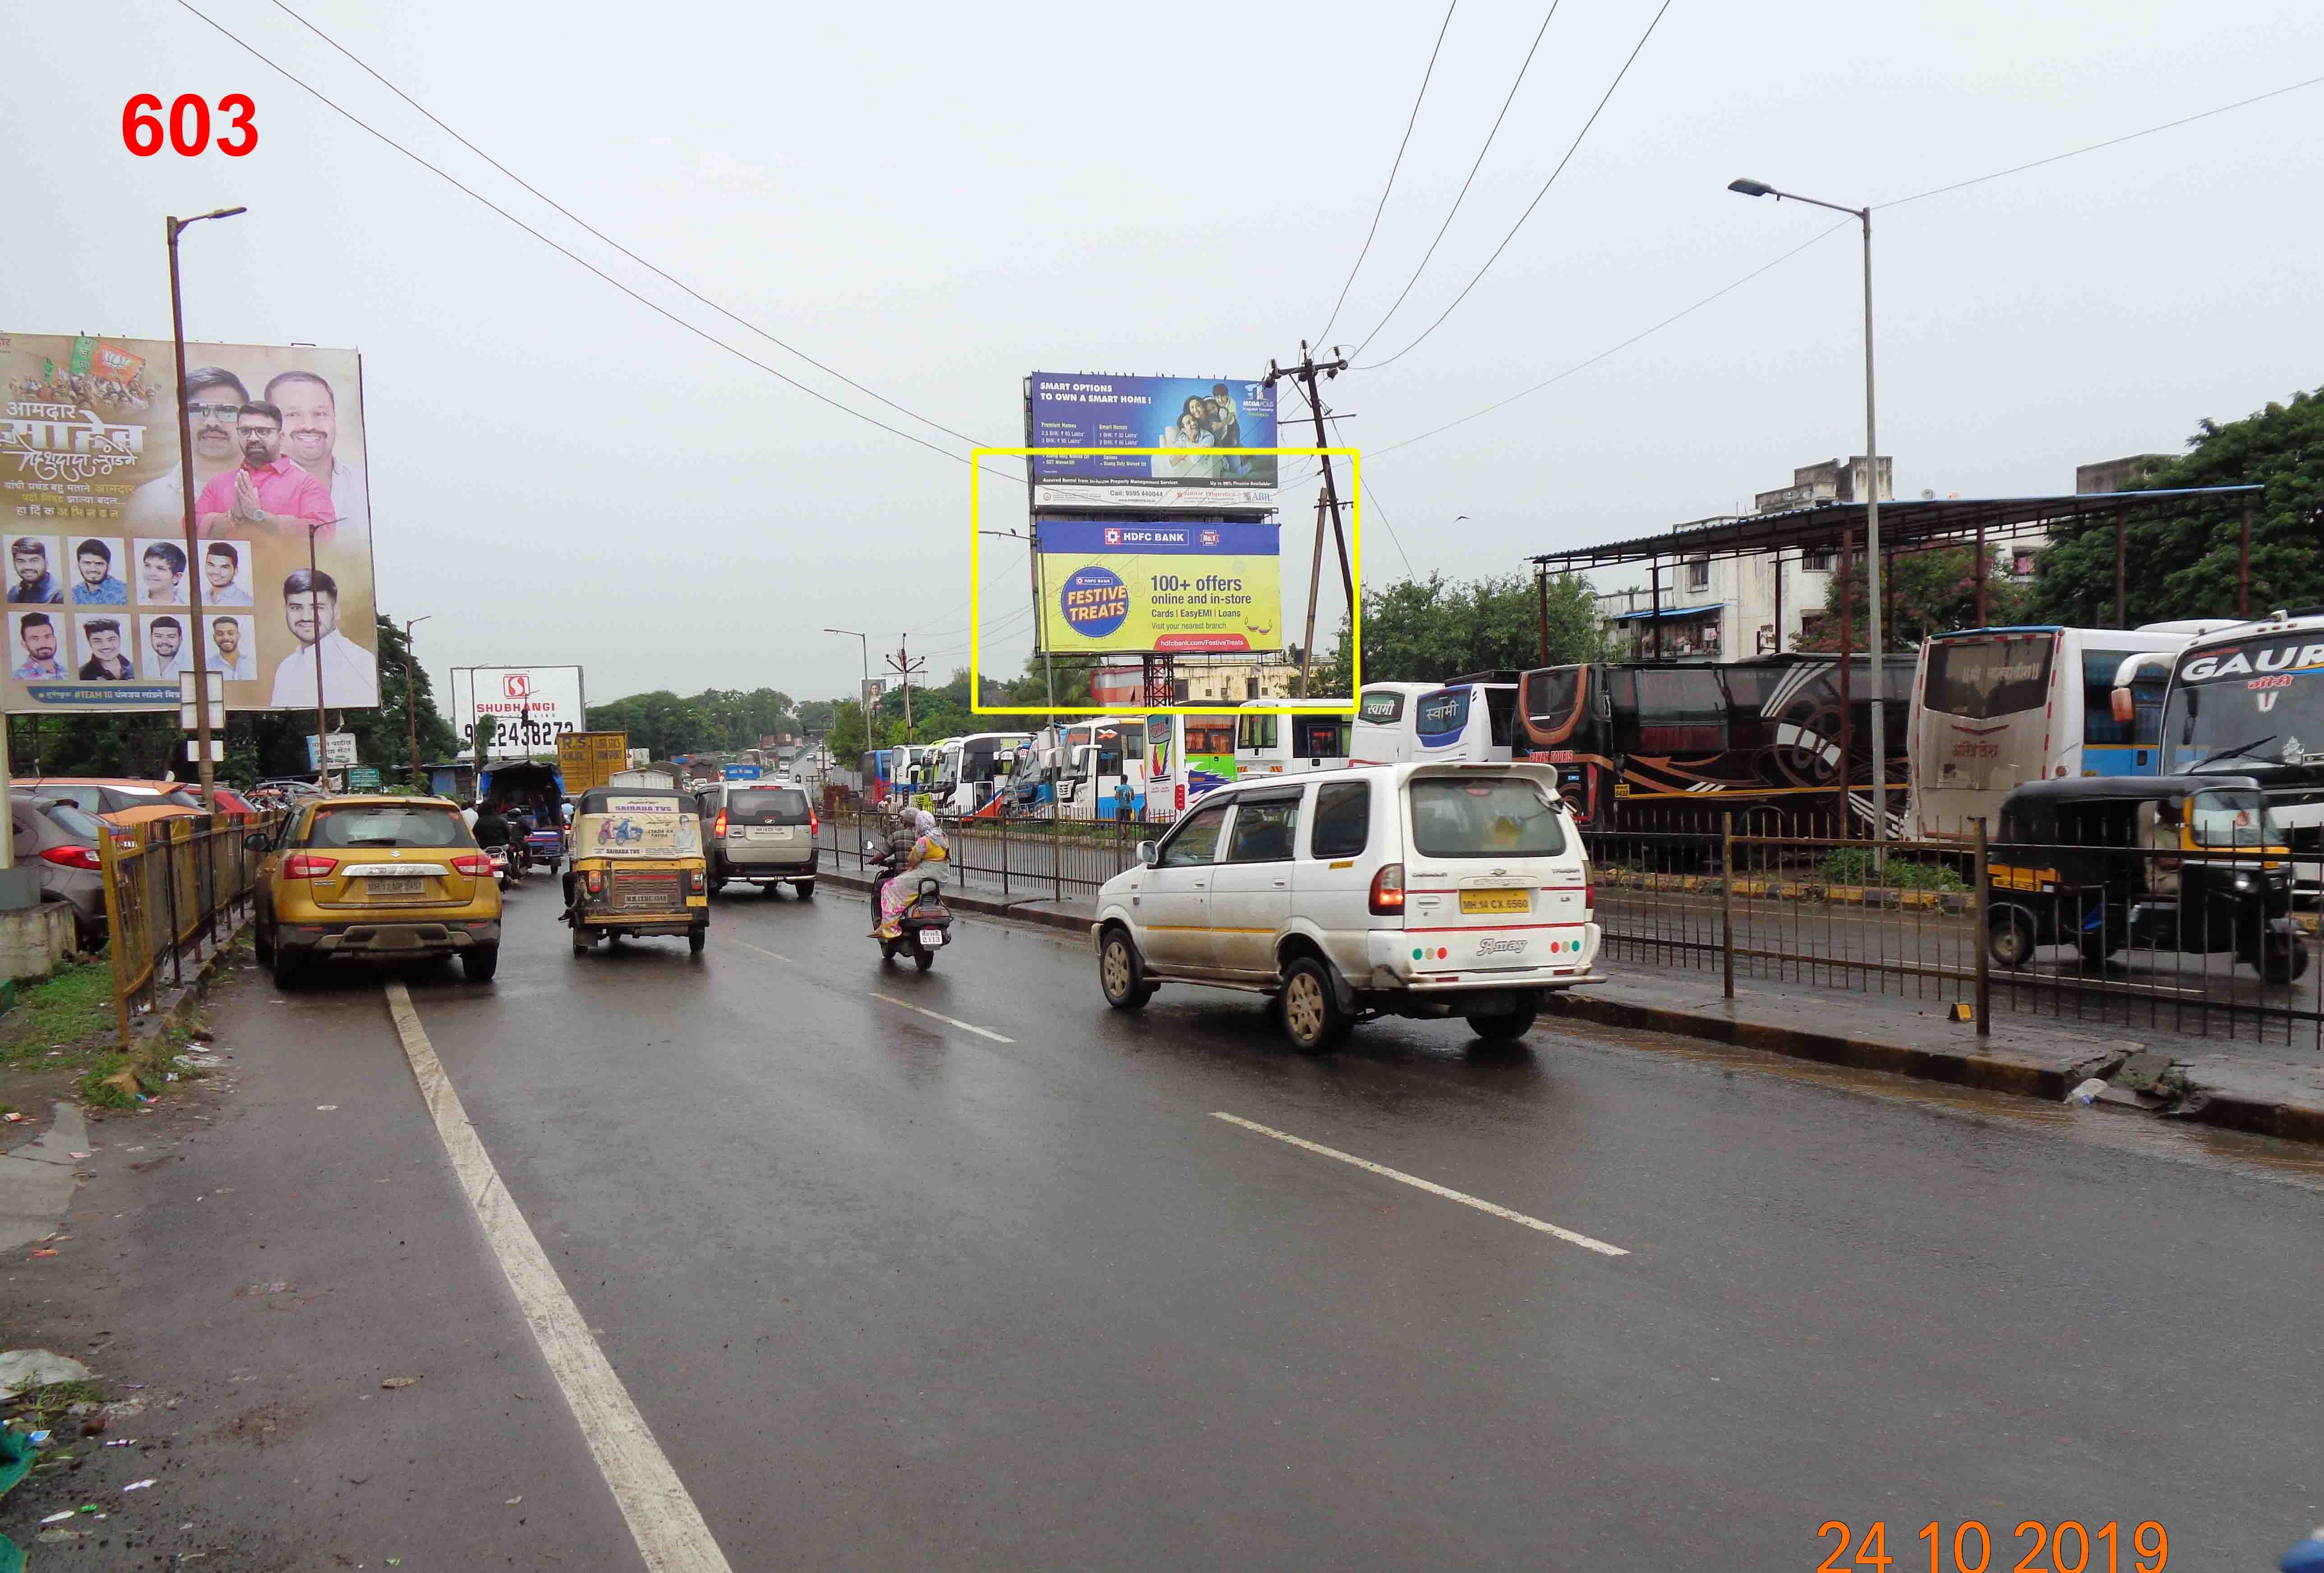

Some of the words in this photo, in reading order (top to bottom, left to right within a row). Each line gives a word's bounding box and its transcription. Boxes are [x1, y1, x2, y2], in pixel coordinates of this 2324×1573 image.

[1040, 382, 1070, 391] SMART
[1073, 384, 1113, 392] OPTIONS
[1055, 393, 1077, 401] OWN
[1088, 395, 1118, 403] SMART
[1120, 396, 1146, 404] HOME
[6, 401, 76, 420] आमदार
[1124, 532, 1152, 541] HDFC
[1155, 533, 1184, 542] BANK
[1151, 575, 1190, 591] 100+
[1196, 575, 1242, 591] offers
[1068, 585, 1127, 605] FESTIVE
[1152, 593, 1184, 604] online
[1187, 594, 1207, 604] and
[1211, 593, 1251, 604] in-store
[1069, 602, 1125, 621] TREATS
[1180, 609, 1212, 618] EasyEMI
[477, 702, 555, 712] SHUBHANGI
[1368, 700, 1395, 715] स्वामी
[1426, 700, 1459, 720] स्वामी
